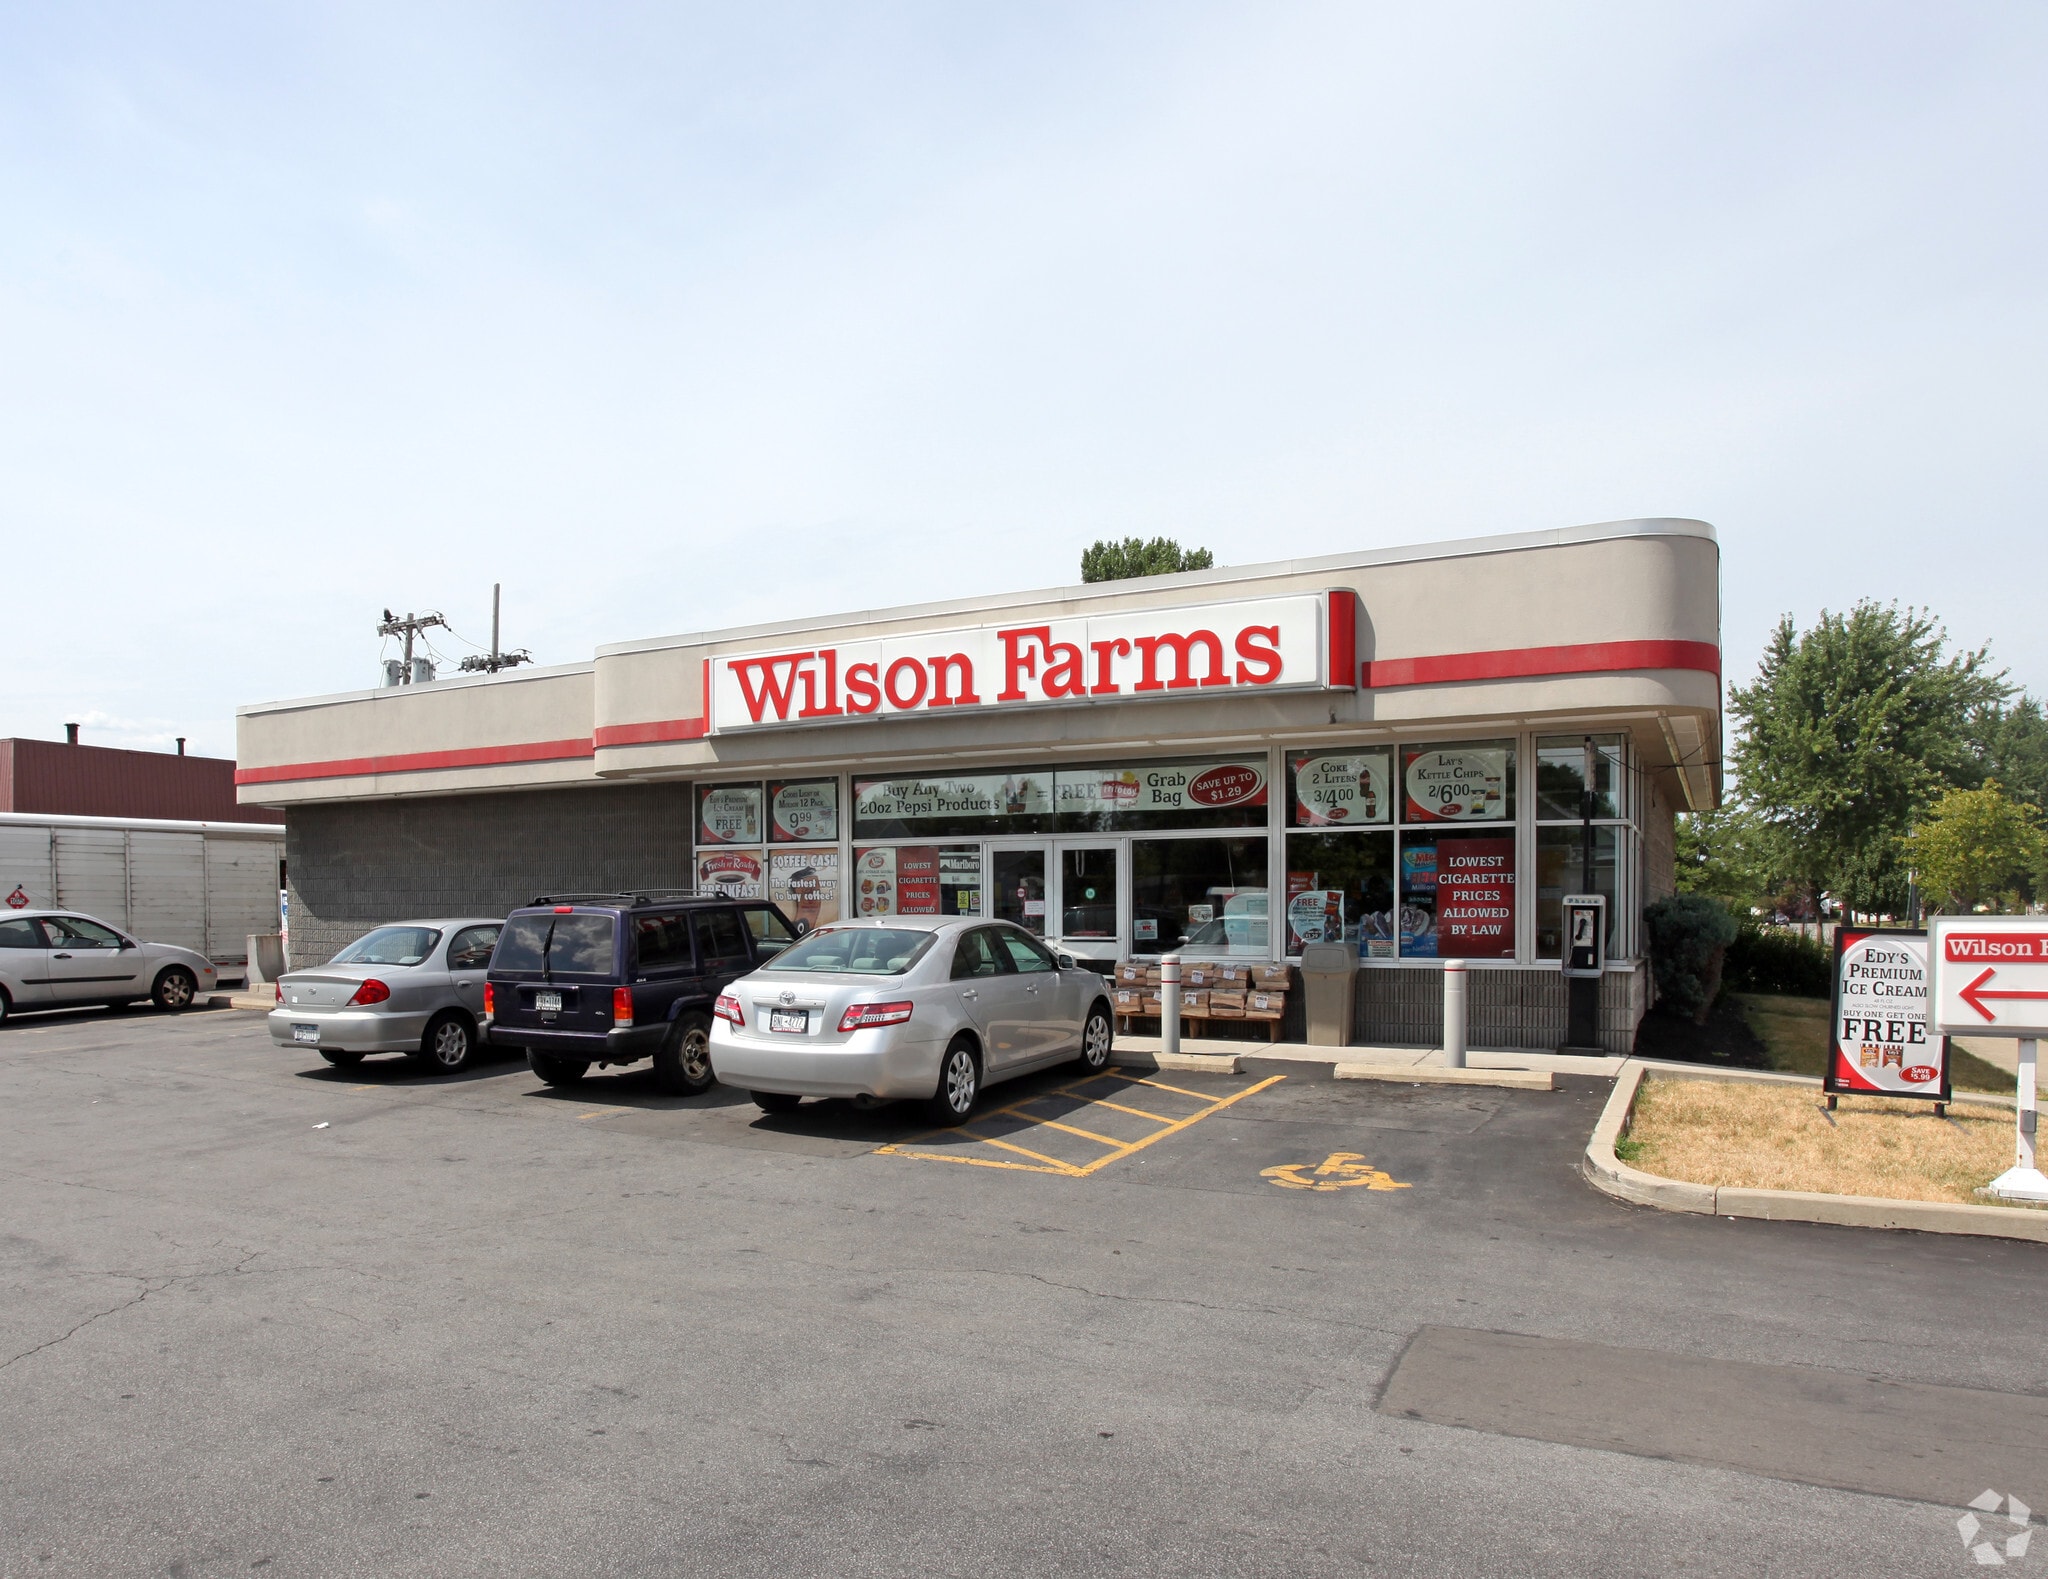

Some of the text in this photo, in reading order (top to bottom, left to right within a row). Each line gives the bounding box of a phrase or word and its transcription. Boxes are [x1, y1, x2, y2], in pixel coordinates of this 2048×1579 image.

[727, 624, 1284, 722] Wilson Farms
[1438, 754, 1463, 766] LAY'S
[1320, 762, 1348, 773] COKE
[1417, 767, 1484, 780] KETTLE CHIPS
[1147, 772, 1186, 787] Grab
[1196, 772, 1253, 791] SAVE UP TO
[1312, 773, 1357, 784] 2 LITERS
[882, 780, 975, 799] Buy Any Two
[1210, 786, 1242, 801] $1.29
[1151, 789, 1182, 806] Bag
[860, 798, 1000, 816] 20oz Pepsi Products
[715, 819, 742, 830] FREE
[733, 858, 755, 871] Ready
[772, 854, 838, 868] COFFEE CASH
[903, 862, 932, 870] LOWEST
[950, 859, 980, 870] Marlboro
[1449, 856, 1505, 867] LOWEST
[771, 879, 785, 888] The
[819, 880, 837, 889] way
[1438, 873, 1515, 885] CIGARETTE
[775, 891, 833, 902] to buy coffee!
[906, 891, 930, 899] PRICES
[1452, 890, 1500, 901] PRICES
[1296, 898, 1319, 906] FREE
[1443, 907, 1510, 918] ALLOWED
[1451, 925, 1502, 935] BY LAW
[1948, 939, 2033, 956] Wilson
[1864, 948, 1909, 964] EDY'S
[1849, 963, 1923, 981] PREMIUM
[1842, 980, 1927, 998] ICE CREAM
[1843, 1009, 1927, 1020] BUY ONE GET ONE
[1842, 1018, 1927, 1044] FREE
